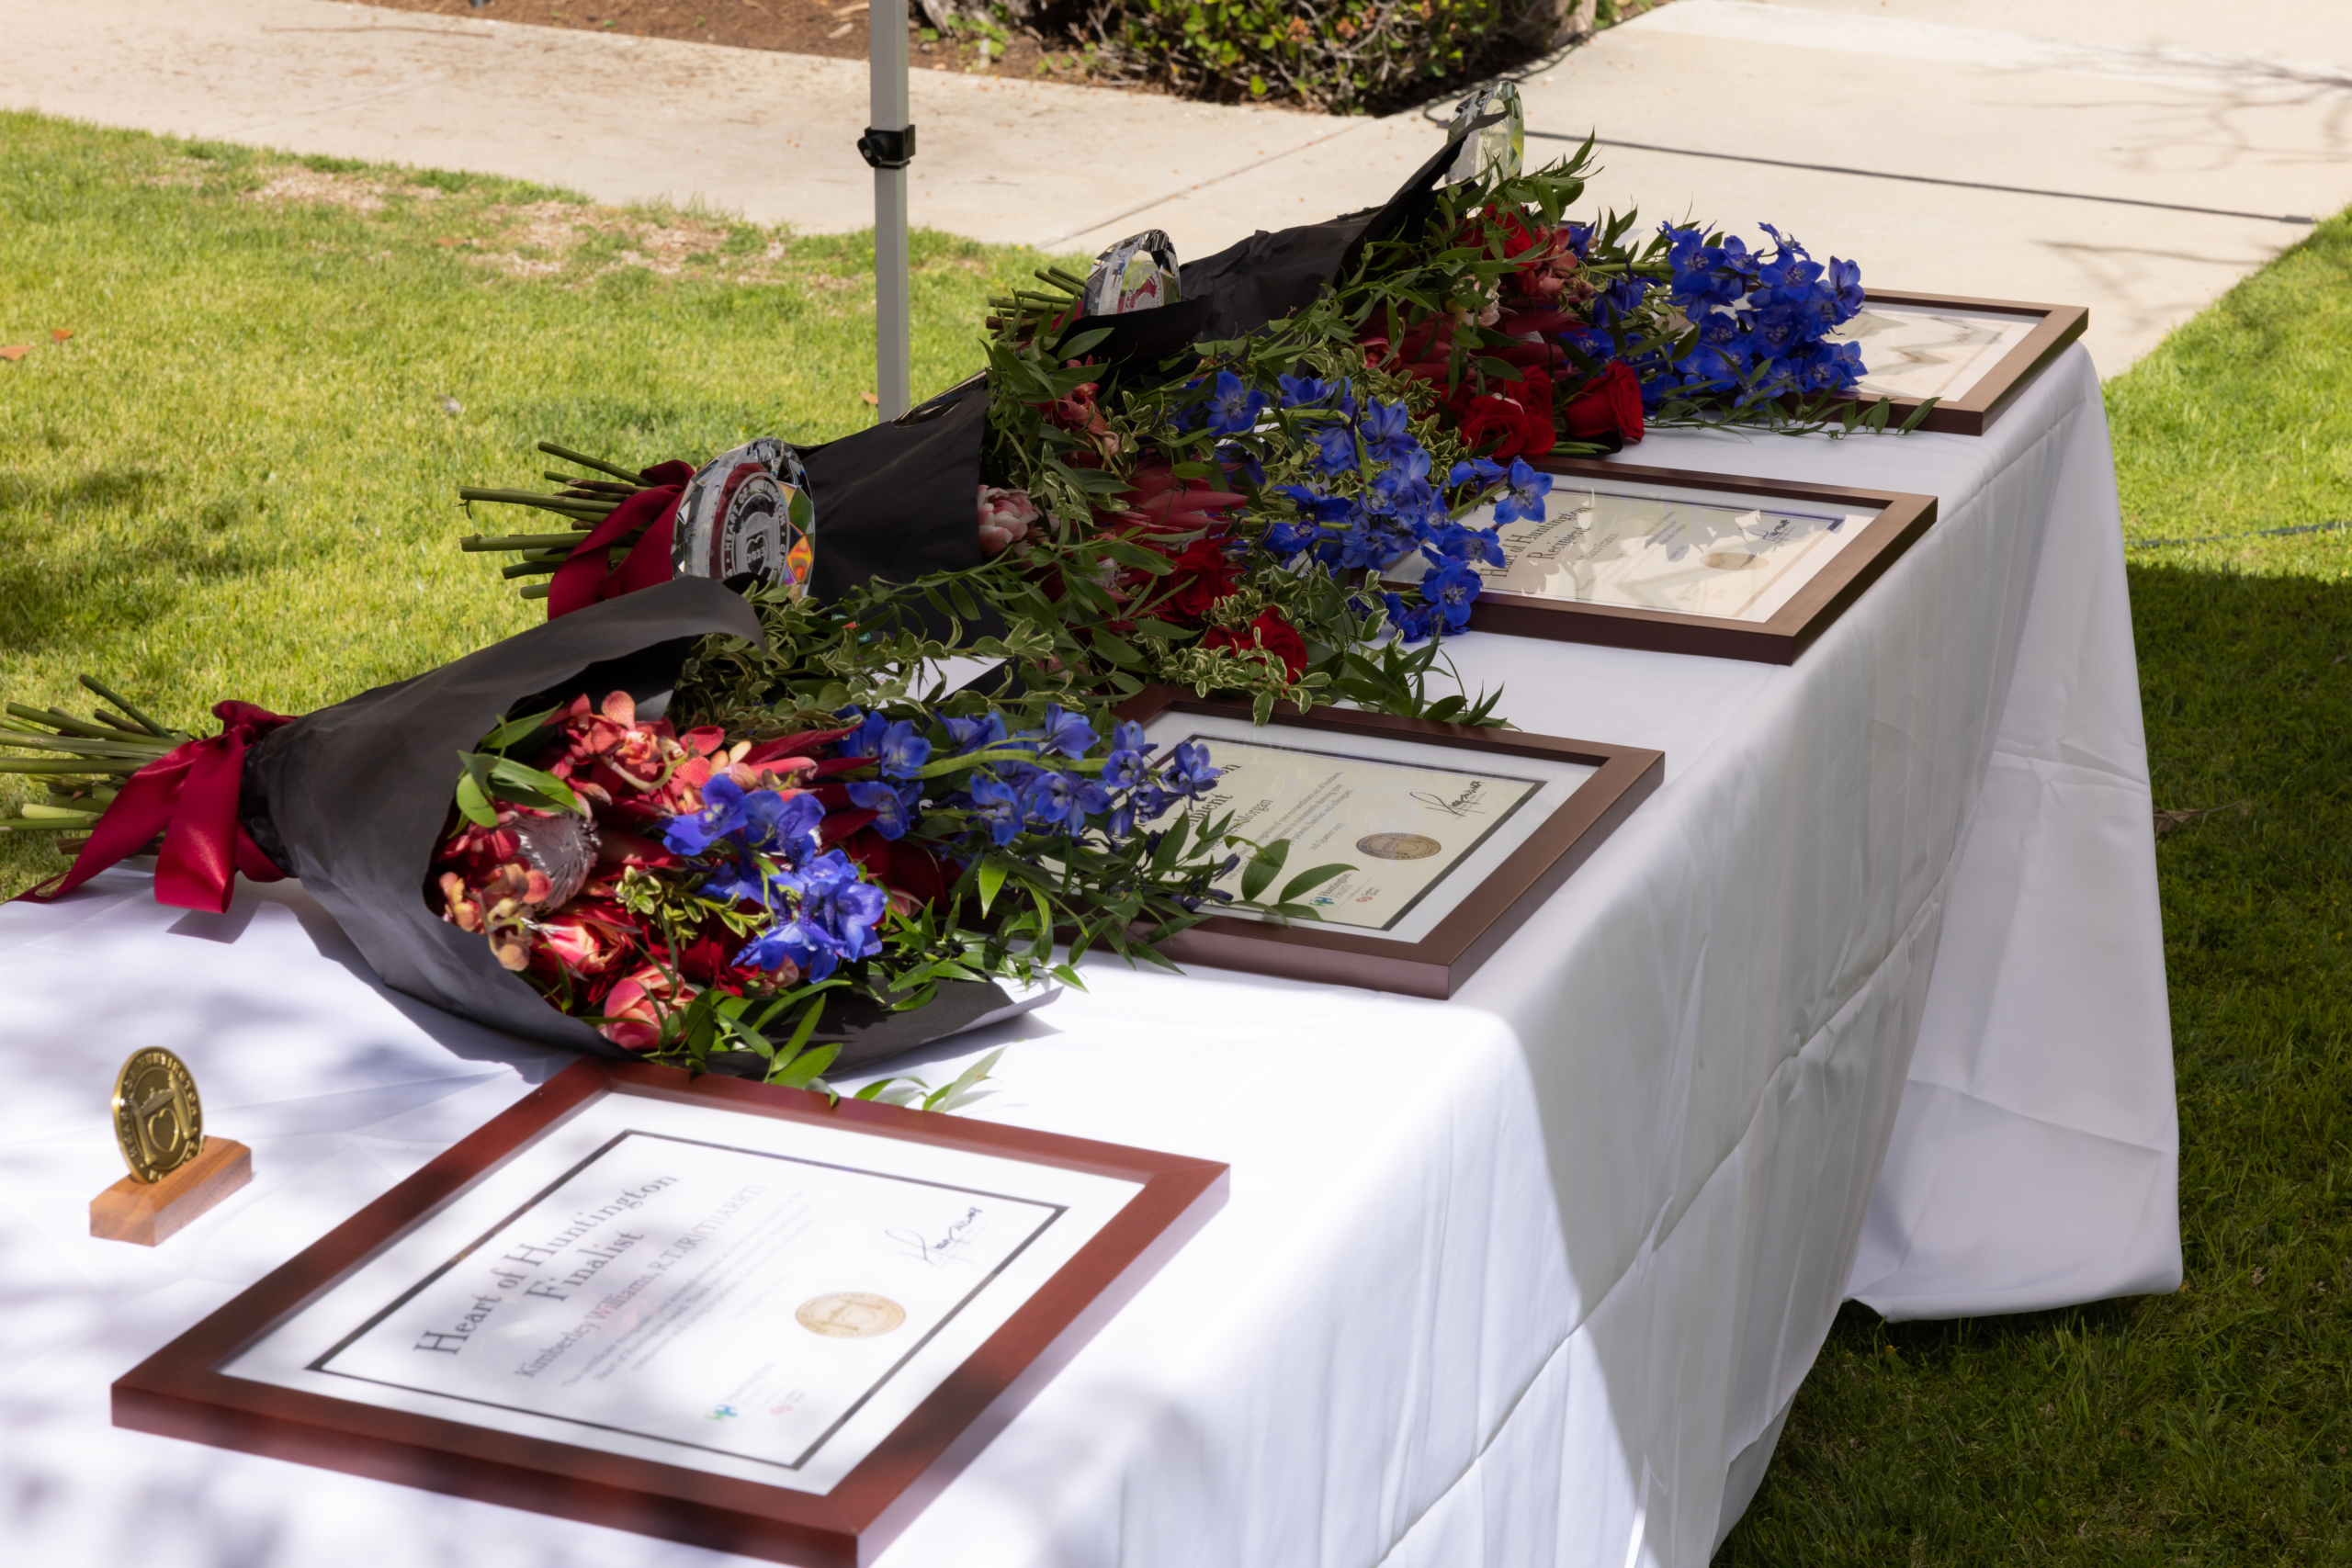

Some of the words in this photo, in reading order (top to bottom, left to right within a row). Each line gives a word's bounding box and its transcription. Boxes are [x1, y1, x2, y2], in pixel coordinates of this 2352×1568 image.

[1504, 505, 1593, 545] Huntington
[1593, 533, 1620, 547] Franco
[746, 546, 766, 564] 2023
[1501, 543, 1523, 553] of
[1526, 525, 1591, 560] Recipient
[1237, 798, 1274, 825] Morgan
[1317, 872, 1353, 897] Huntington
[506, 1176, 676, 1266] Huntington
[491, 1268, 529, 1292] of
[524, 1232, 648, 1299] Finalist
[413, 1295, 502, 1354] Heart
[514, 1321, 603, 1377] Kimberley
[586, 1272, 662, 1319] Williams,
